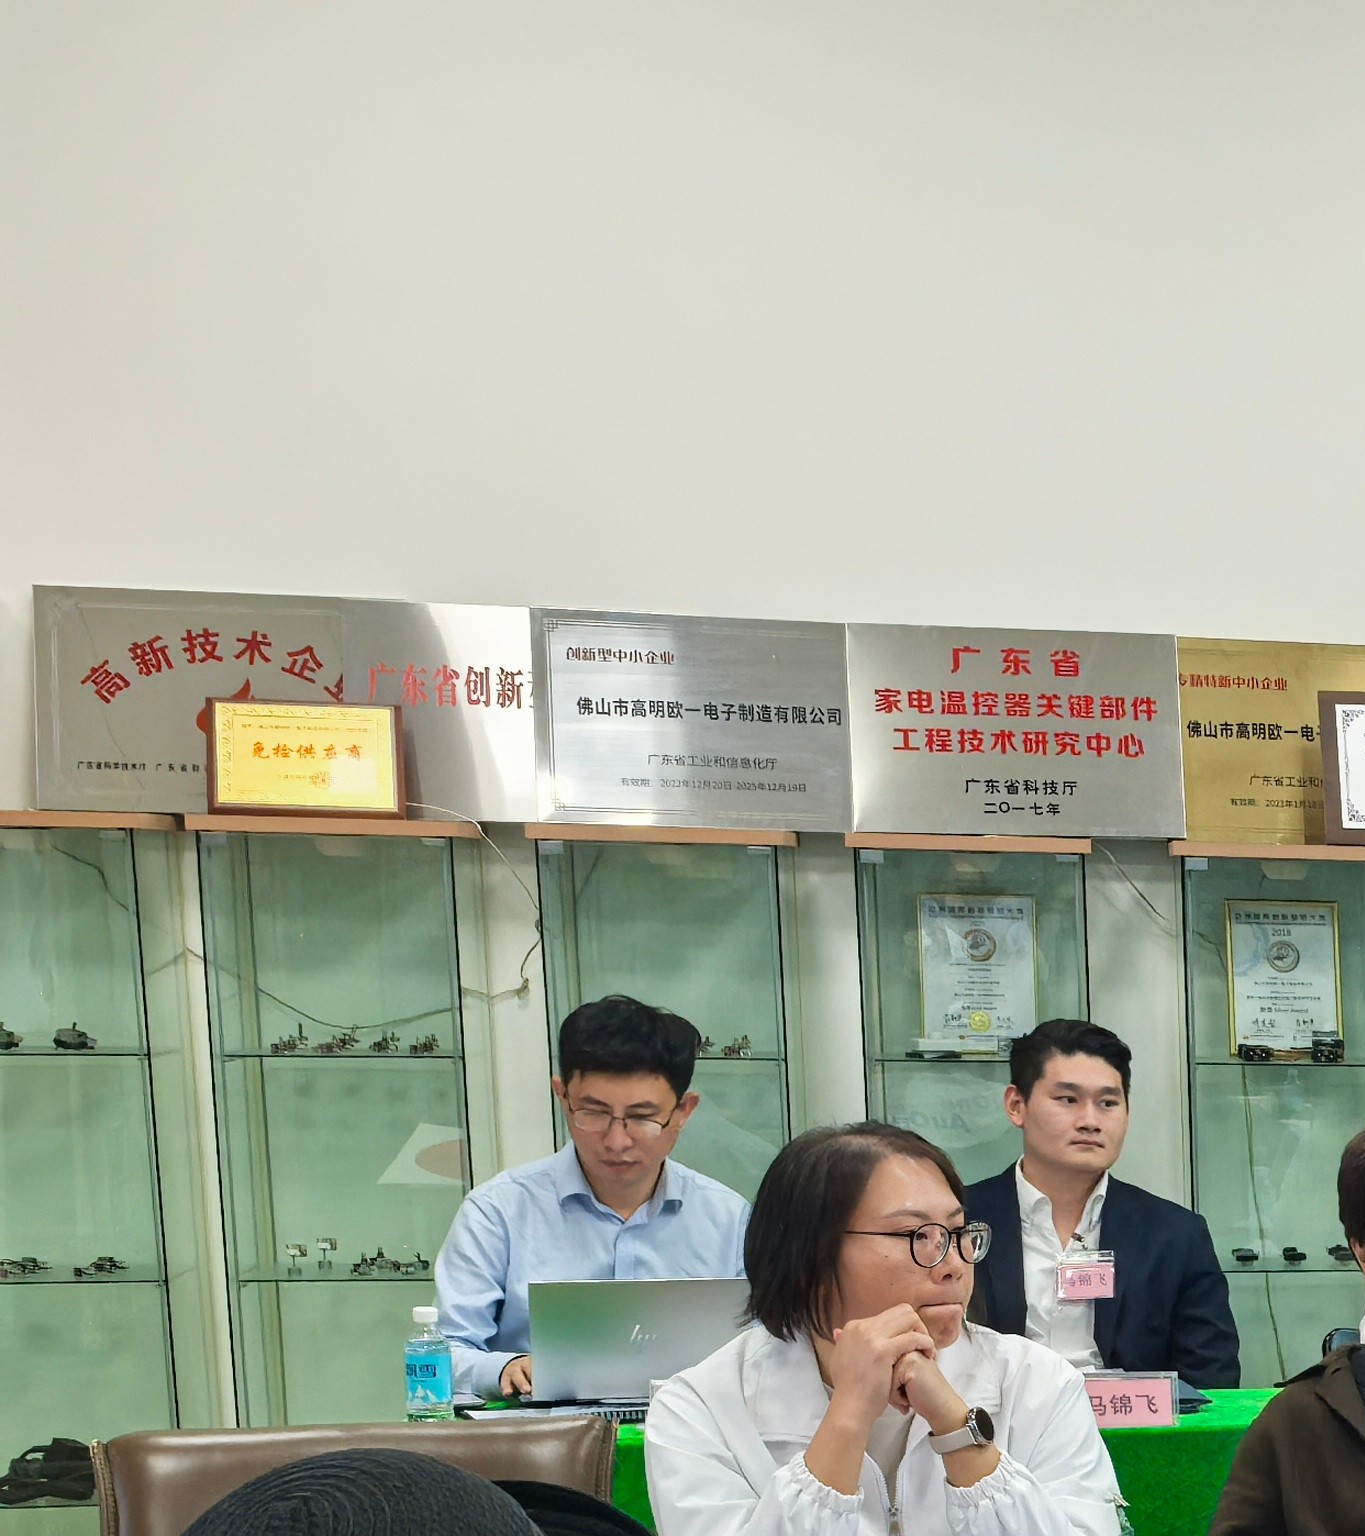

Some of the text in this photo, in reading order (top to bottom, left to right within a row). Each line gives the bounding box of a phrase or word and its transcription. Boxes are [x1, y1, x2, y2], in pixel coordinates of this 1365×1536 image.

[566, 646, 676, 665] 创新型中小企业
[951, 646, 1081, 678] 广东省
[367, 663, 535, 708] 广东省创新
[577, 696, 843, 726] 佛山市高明欧一电子制造有限公司
[874, 688, 1158, 722] 家电温控器关键部件
[893, 728, 1145, 758] 工程技术研究中心
[1187, 720, 1320, 742] 佛山市高明欧一电
[965, 779, 1078, 796] 广东省科技厅
[1249, 774, 1323, 788] 广东省工业和
[1090, 1394, 1158, 1416] 马锦飞
